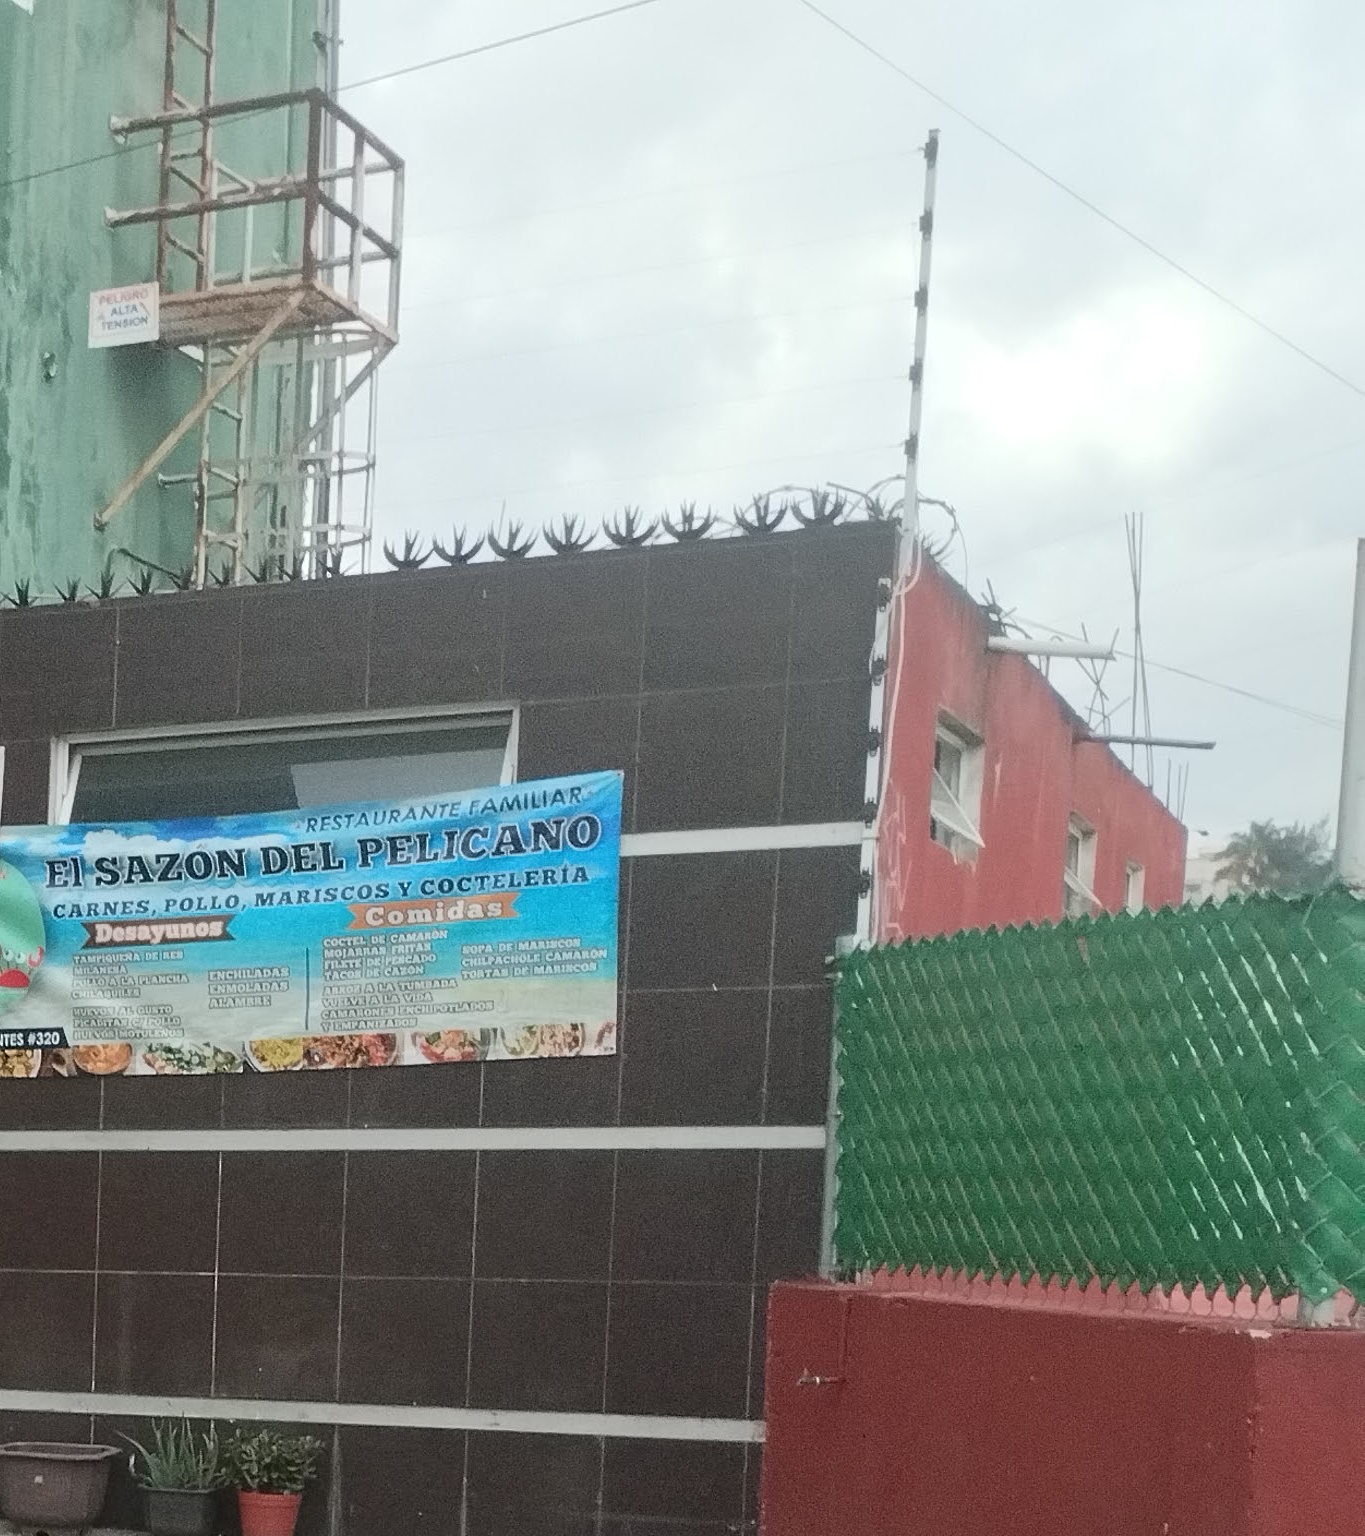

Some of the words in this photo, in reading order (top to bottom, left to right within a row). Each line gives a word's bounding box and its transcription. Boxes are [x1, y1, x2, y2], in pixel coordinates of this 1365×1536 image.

[110, 304, 139, 316] ALTA
[102, 316, 148, 330] TENSION
[305, 801, 462, 833] RESTAURANTE
[469, 787, 582, 815] FAMILIAR
[261, 842, 344, 875] DEL
[357, 814, 601, 868] PELICANO
[53, 900, 156, 919] CARNES,
[164, 893, 246, 912] POLLO,
[254, 882, 389, 908] MARISCOS
[398, 881, 413, 897] Y
[421, 861, 589, 895] COCTELERÍA
[365, 900, 503, 926] Comidas
[95, 921, 223, 944] Desayunos
[323, 936, 366, 947] COCTEL
[371, 935, 386, 944] DE
[462, 944, 493, 955] SOPA
[498, 943, 514, 952] DE
[518, 938, 581, 951] MARISCOS
[145, 951, 159, 961] DE
[162, 950, 184, 960] RES
[324, 947, 387, 958] MOJARRAS
[391, 943, 431, 955] FRITAS
[324, 959, 362, 969] FILETE
[367, 958, 382, 968] DE
[385, 954, 437, 966] PESCADO
[461, 953, 541, 967] CHILPACHOLE
[73, 965, 128, 976] MILANESA
[209, 967, 290, 980] ENCHILADAS
[324, 970, 362, 981] TACOS
[366, 969, 381, 978] DE
[461, 968, 509, 980] TORTAS
[513, 967, 529, 977] DE
[533, 961, 597, 975] MARISCOS
[73, 977, 106, 987] POLLO
[109, 977, 118, 986] A
[120, 976, 136, 986] LA
[138, 974, 189, 985] PLANCHA
[324, 985, 362, 996] ARROZ
[365, 983, 375, 993] A
[378, 983, 395, 993] LA
[398, 978, 458, 992] TUMBADA
[71, 988, 141, 999] CHILAQUILES
[209, 981, 289, 995] ENMOLADAS
[209, 995, 271, 1009] ALAMBRE
[322, 997, 366, 1008] VUELVE
[369, 995, 379, 1005] A
[383, 994, 400, 1005] LA
[404, 992, 433, 1003] VIDA
[73, 1006, 116, 1017] HUEVOS
[119, 1006, 134, 1016] AL
[137, 1005, 173, 1016] GUSTO
[321, 1007, 395, 1020] CAMARONES
[399, 1000, 494, 1015] ENCHIPOTLADOS
[73, 1018, 129, 1028] PICADITAS
[148, 1016, 181, 1026] POLLO
[321, 1022, 331, 1032] Y
[333, 1018, 417, 1031] EMPANIZADOS
[27, 1031, 60, 1046] #320
[73, 1030, 116, 1040] HUEVOS
